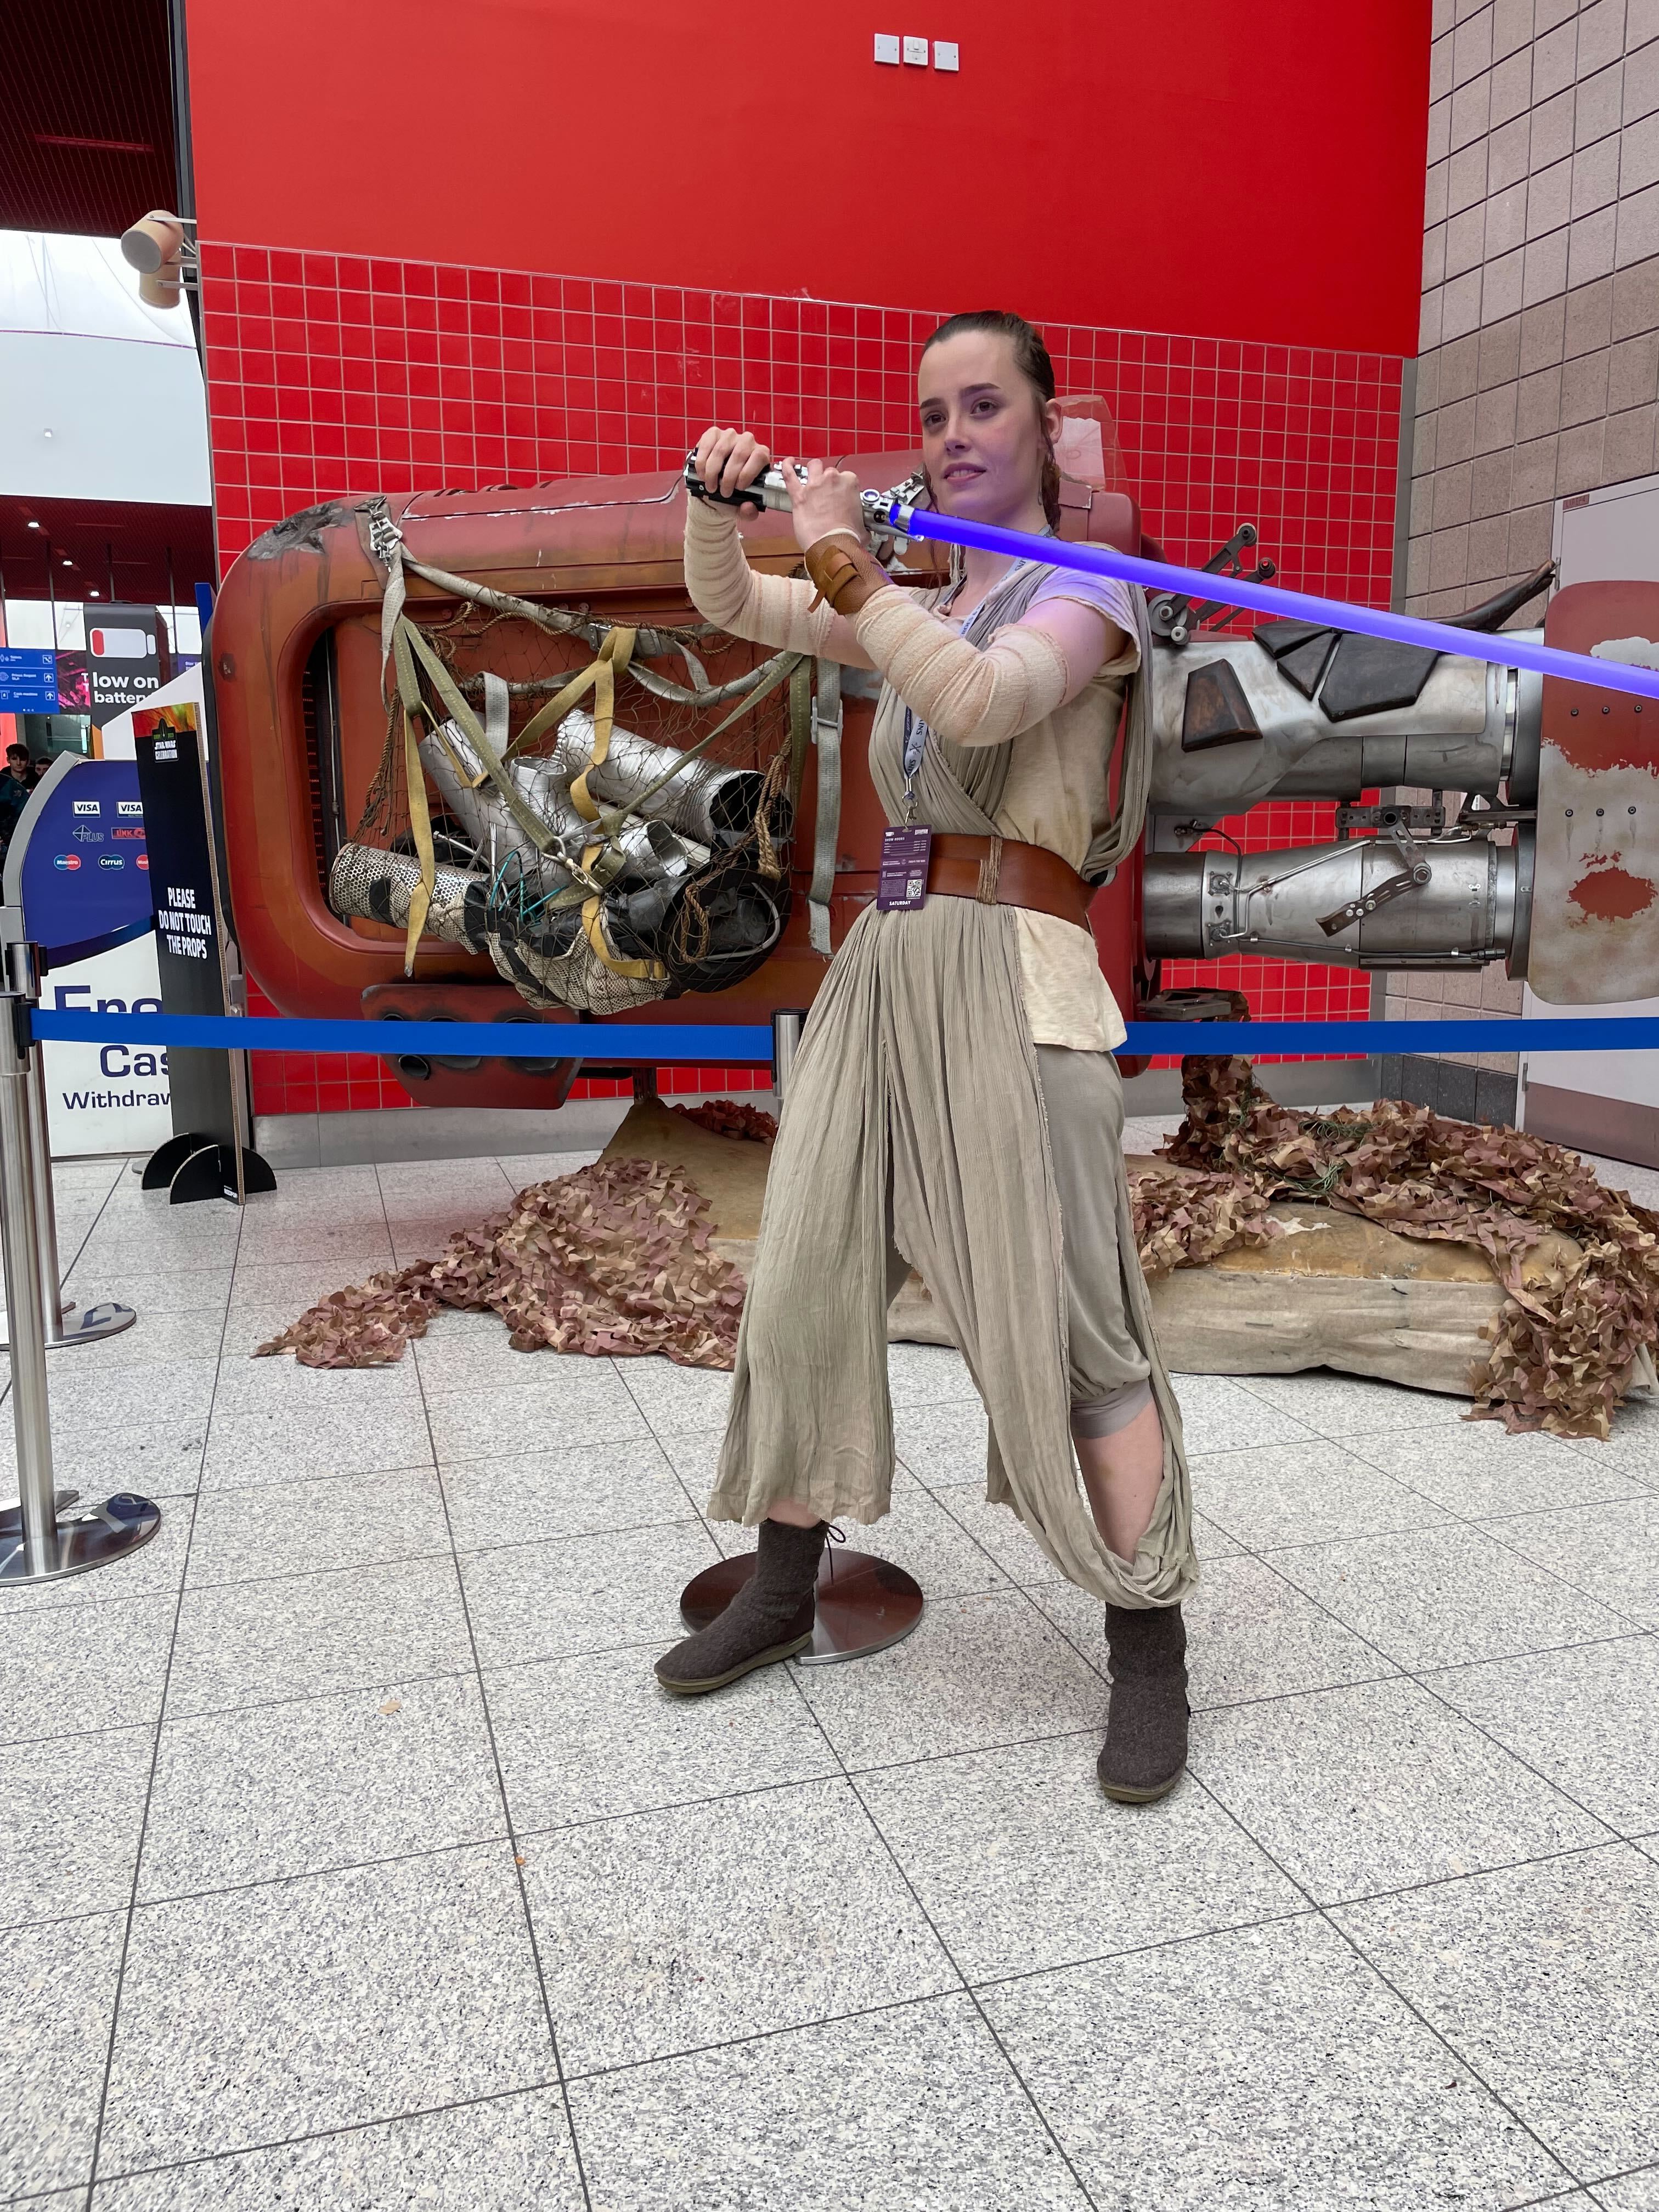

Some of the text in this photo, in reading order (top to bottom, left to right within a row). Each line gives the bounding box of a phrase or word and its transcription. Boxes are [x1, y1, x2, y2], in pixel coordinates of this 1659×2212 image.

[93, 672, 159, 689] low on
[94, 690, 148, 704] batter
[82, 832, 104, 842] PLUS
[116, 828, 132, 837] LINK
[167, 887, 196, 909] PLEASE
[158, 910, 212, 935] DO NOT TOUCH
[166, 934, 207, 959] THE PROPS
